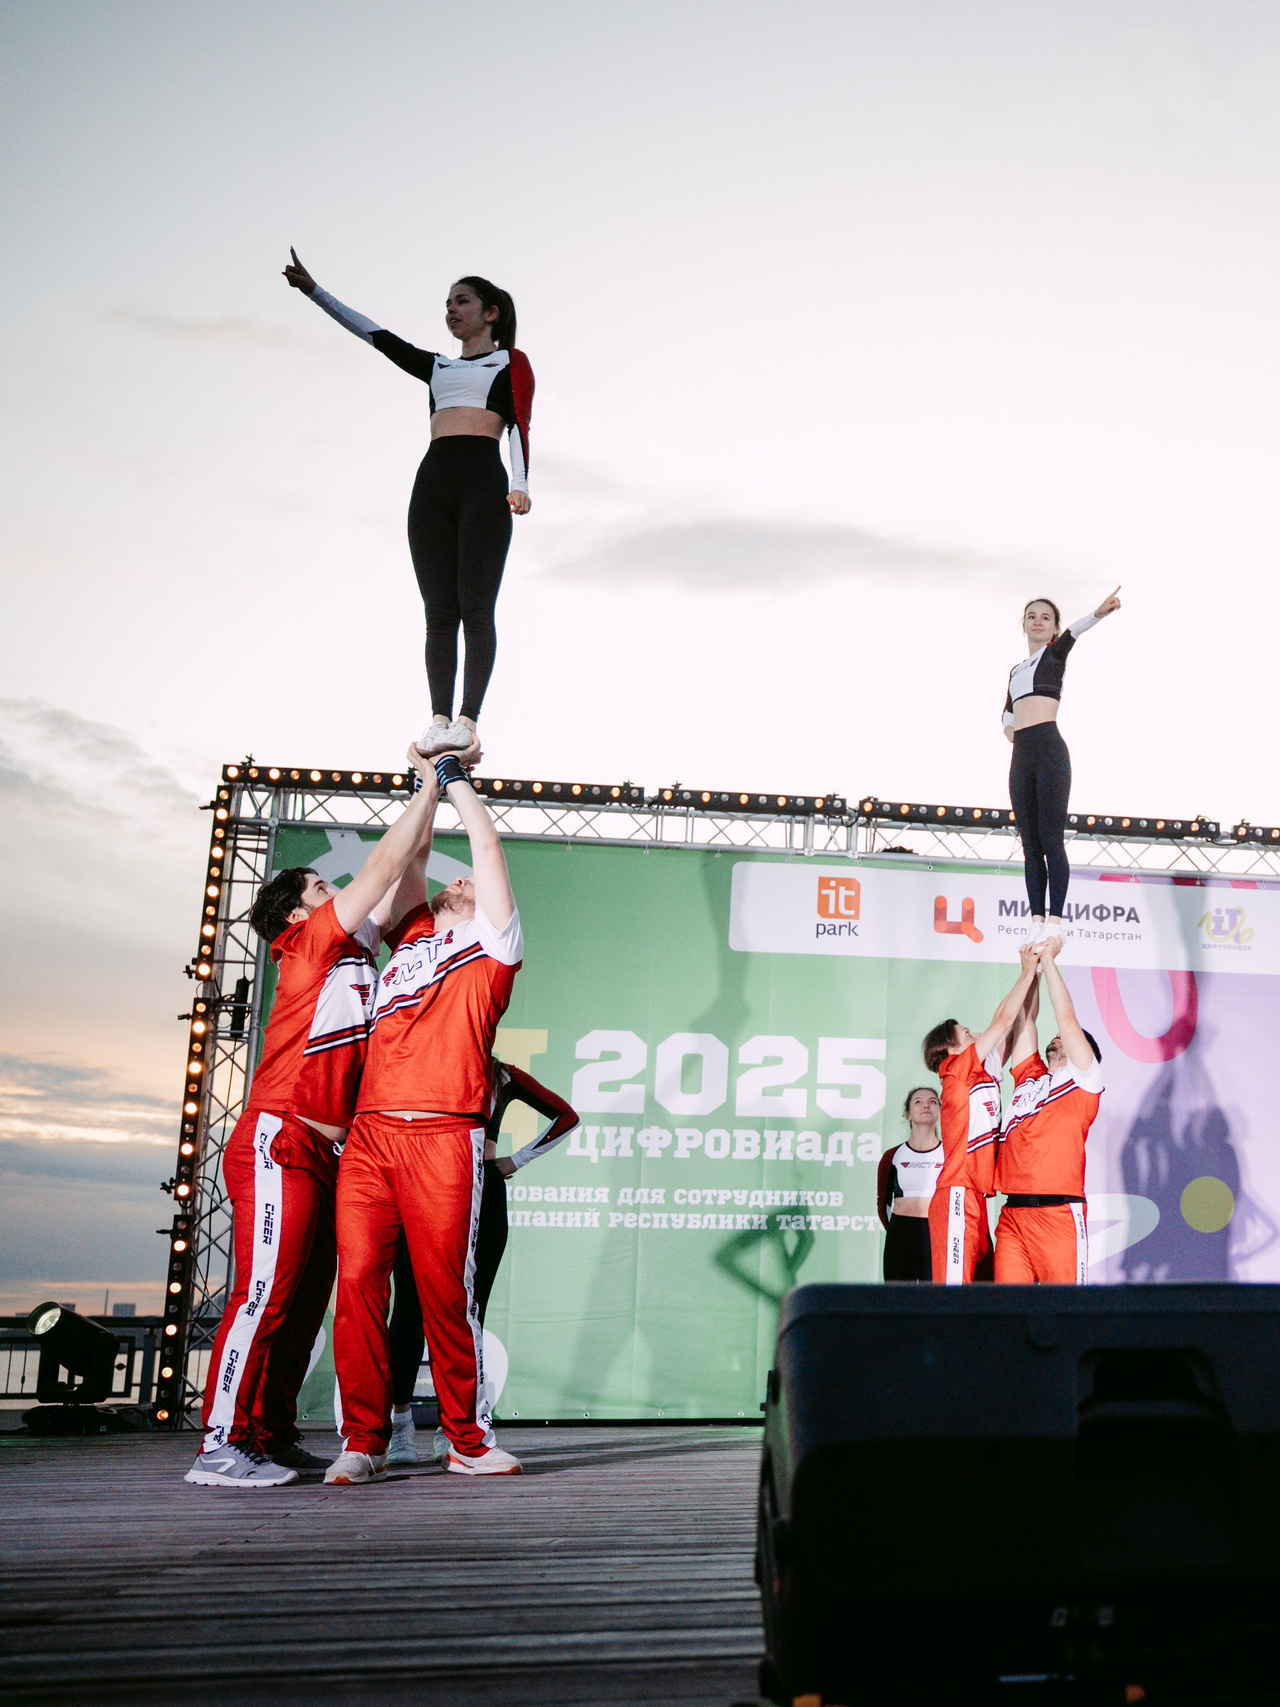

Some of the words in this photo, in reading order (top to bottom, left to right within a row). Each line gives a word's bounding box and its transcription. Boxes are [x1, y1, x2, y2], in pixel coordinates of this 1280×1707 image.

[821, 880, 856, 915] it
[816, 921, 859, 938] park
[1077, 928, 1142, 941] Татарстан
[571, 1029, 887, 1120] 2025
[263, 1203, 275, 1246] CHEER
[952, 1237, 960, 1265] CHEER
[222, 1349, 239, 1394] CHEER
